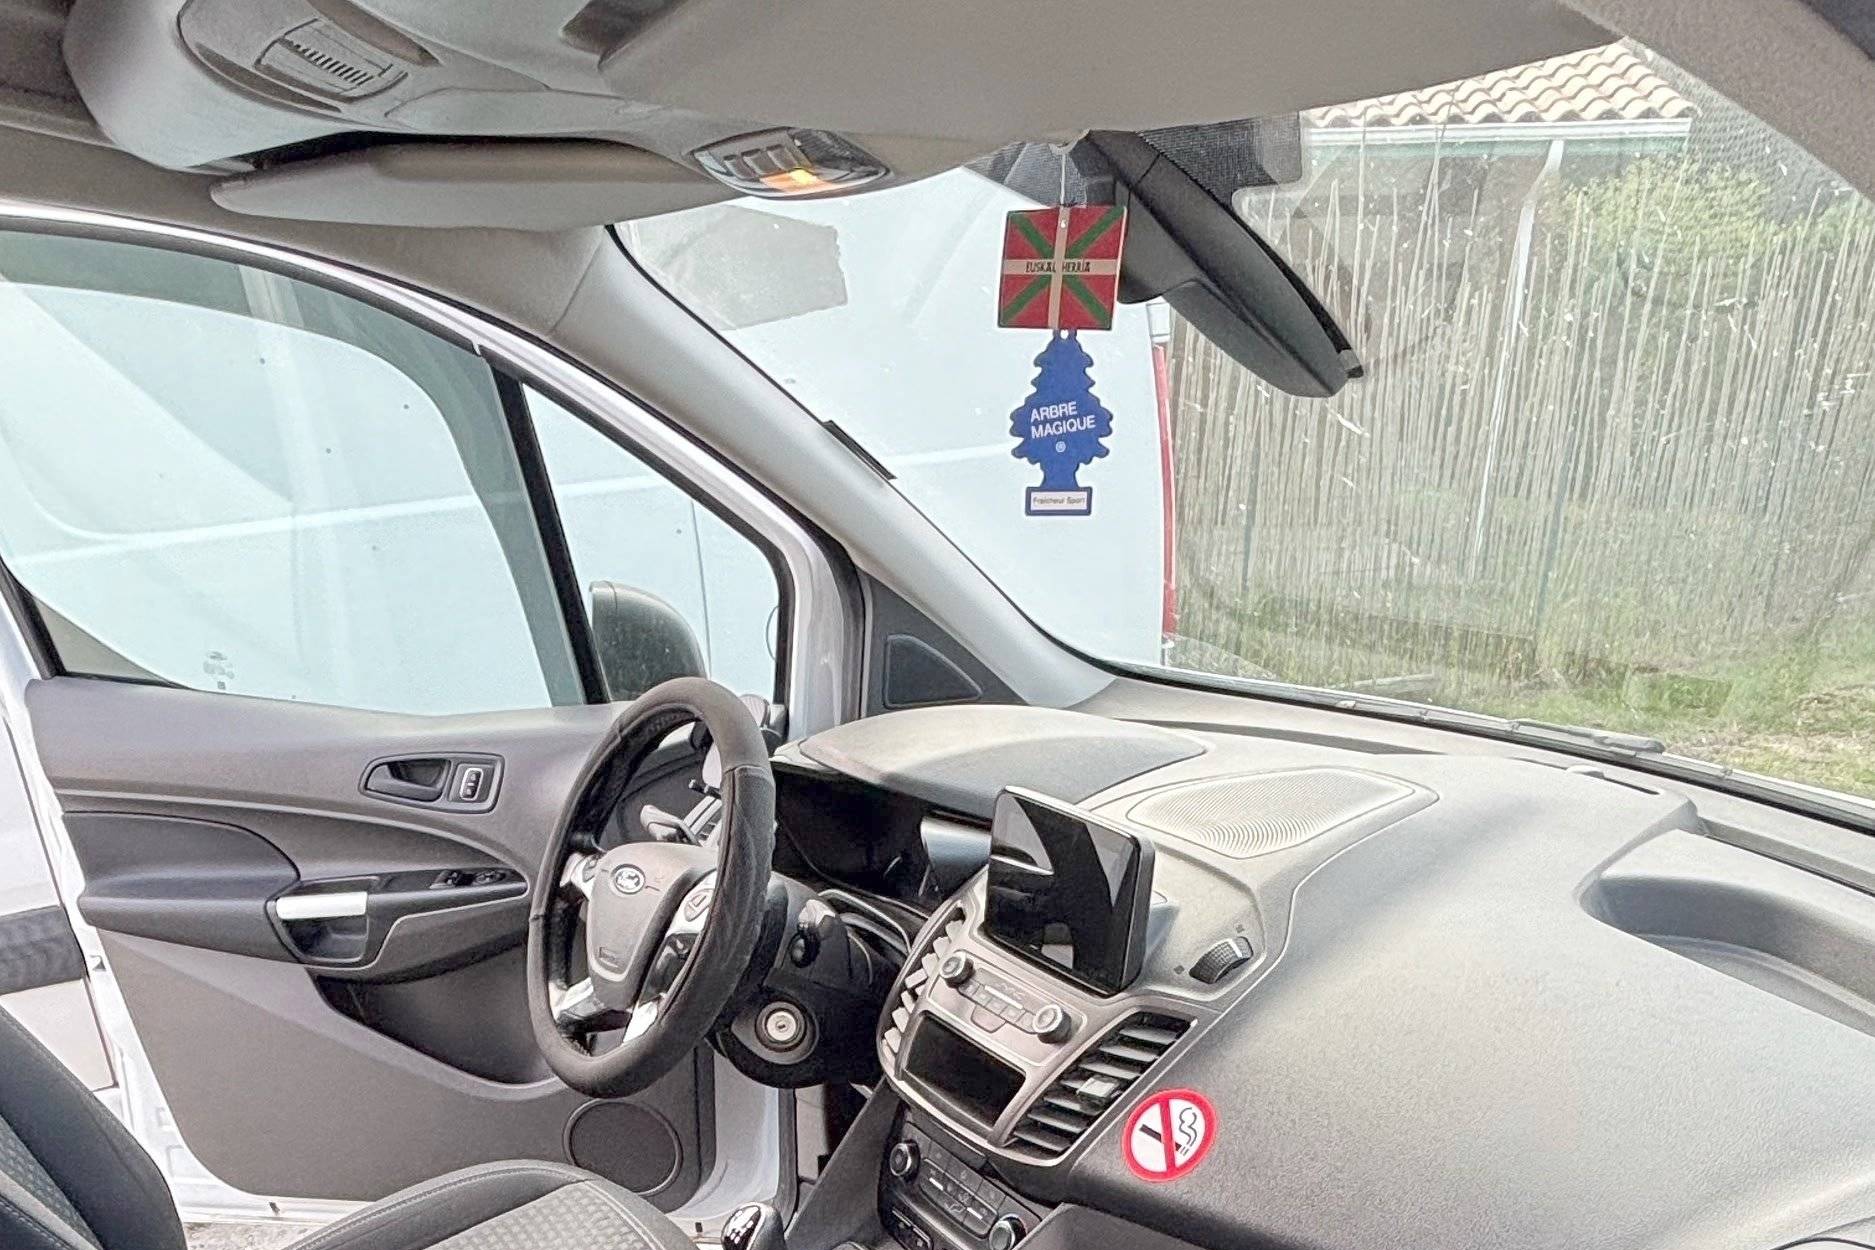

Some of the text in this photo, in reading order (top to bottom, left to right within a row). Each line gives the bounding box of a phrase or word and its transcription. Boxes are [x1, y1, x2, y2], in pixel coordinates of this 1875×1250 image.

[1025, 261, 1057, 273] EUSKAL
[1031, 401, 1078, 423] ARBRE
[1031, 415, 1097, 439] MAGIQUE
